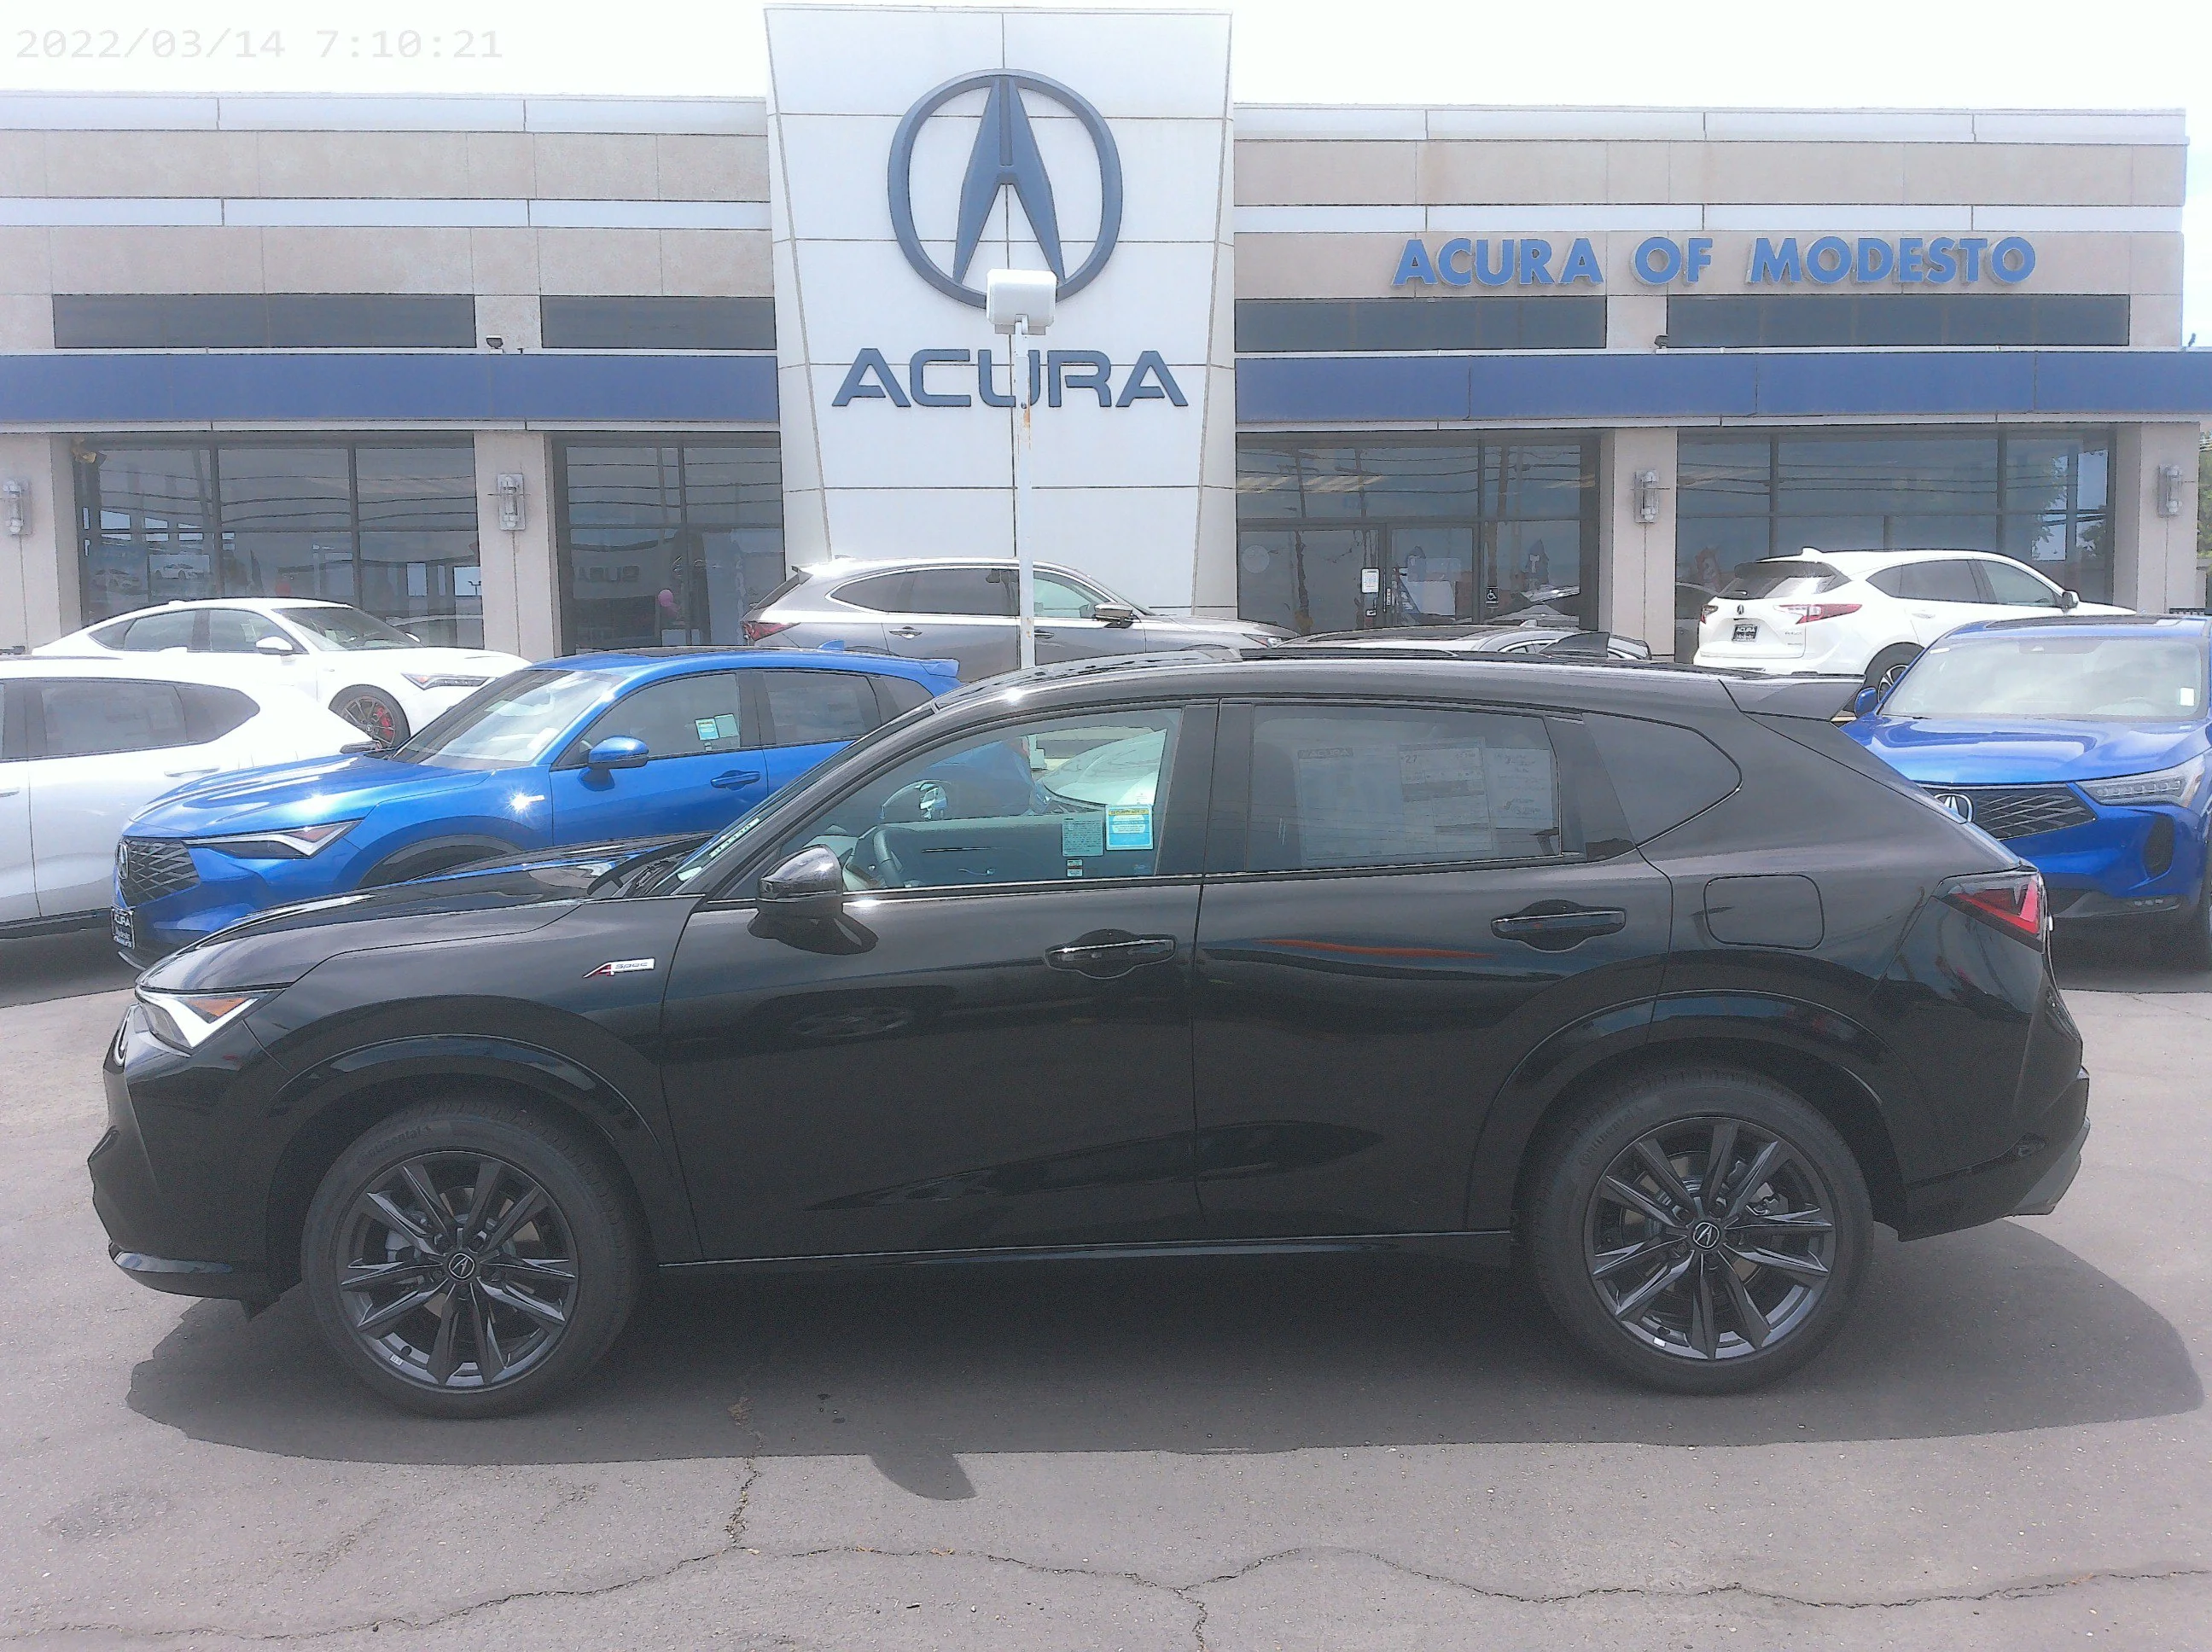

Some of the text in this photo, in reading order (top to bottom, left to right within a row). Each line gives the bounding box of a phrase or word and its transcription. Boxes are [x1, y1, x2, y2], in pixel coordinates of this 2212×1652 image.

[1391, 236, 2037, 287] ACURA OF MODESTO
[831, 347, 1189, 408] ACURA
